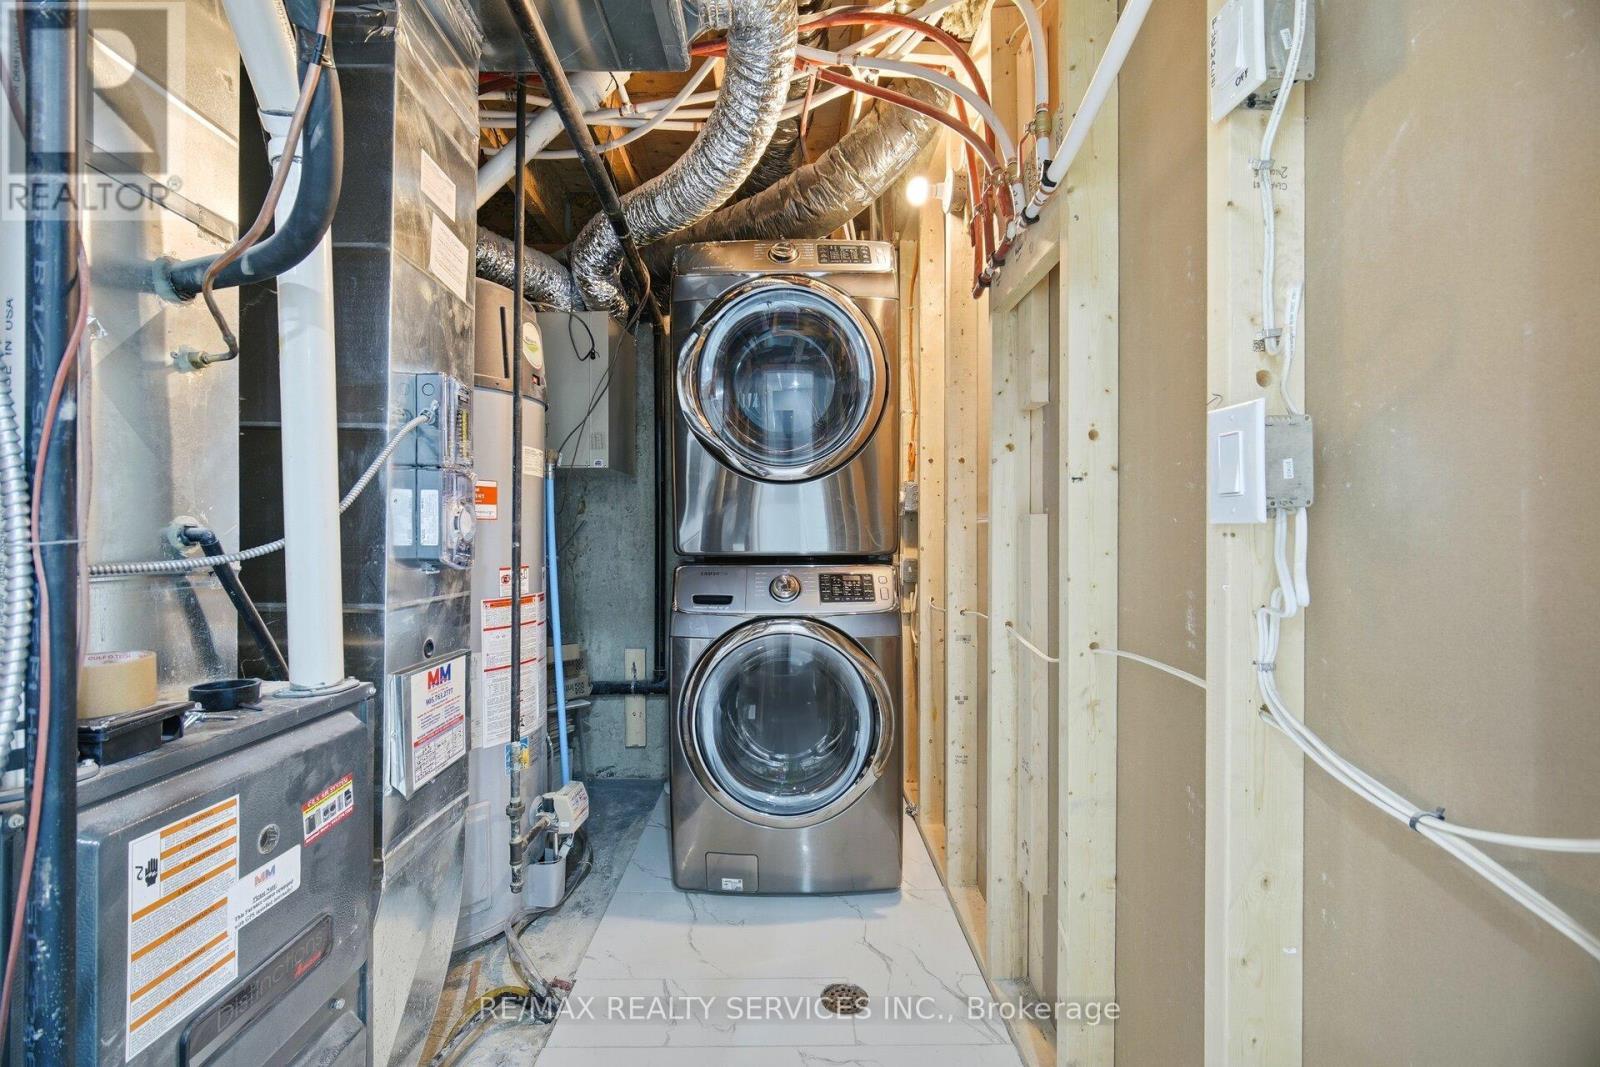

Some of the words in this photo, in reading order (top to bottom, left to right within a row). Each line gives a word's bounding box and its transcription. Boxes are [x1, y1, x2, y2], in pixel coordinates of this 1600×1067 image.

[1234, 67, 1249, 87] OFF
[5, 297, 14, 331] USA
[5, 340, 13, 356] IN
[427, 663, 452, 690] MM
